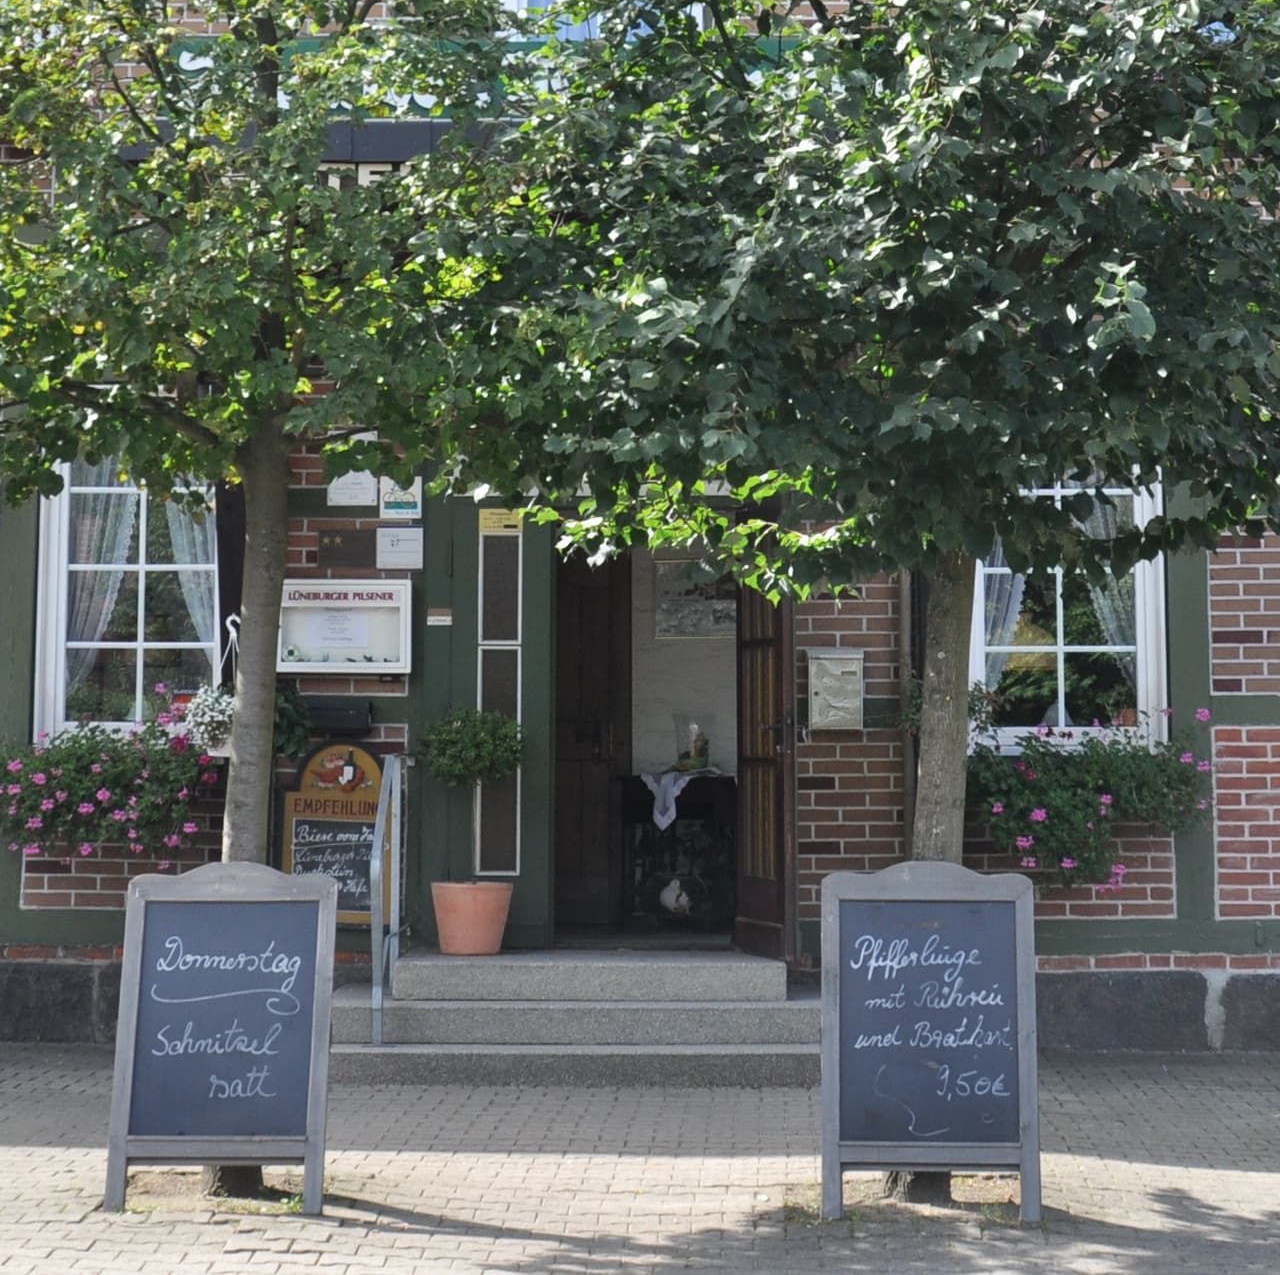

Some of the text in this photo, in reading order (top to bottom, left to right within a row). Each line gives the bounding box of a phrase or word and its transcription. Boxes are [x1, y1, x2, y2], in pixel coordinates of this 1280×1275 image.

[288, 590, 394, 601] LÜNEBURGER PILSENER
[360, 826, 375, 841] Fa
[157, 936, 301, 993] Donnerstag
[850, 934, 982, 982] Pfifferlinge
[864, 977, 1004, 1009] mit Rührei
[152, 1019, 282, 1056] Schnitzel
[854, 1025, 902, 1048] und
[209, 1065, 277, 1098] satt
[937, 1065, 1010, 1101] 9,50€
